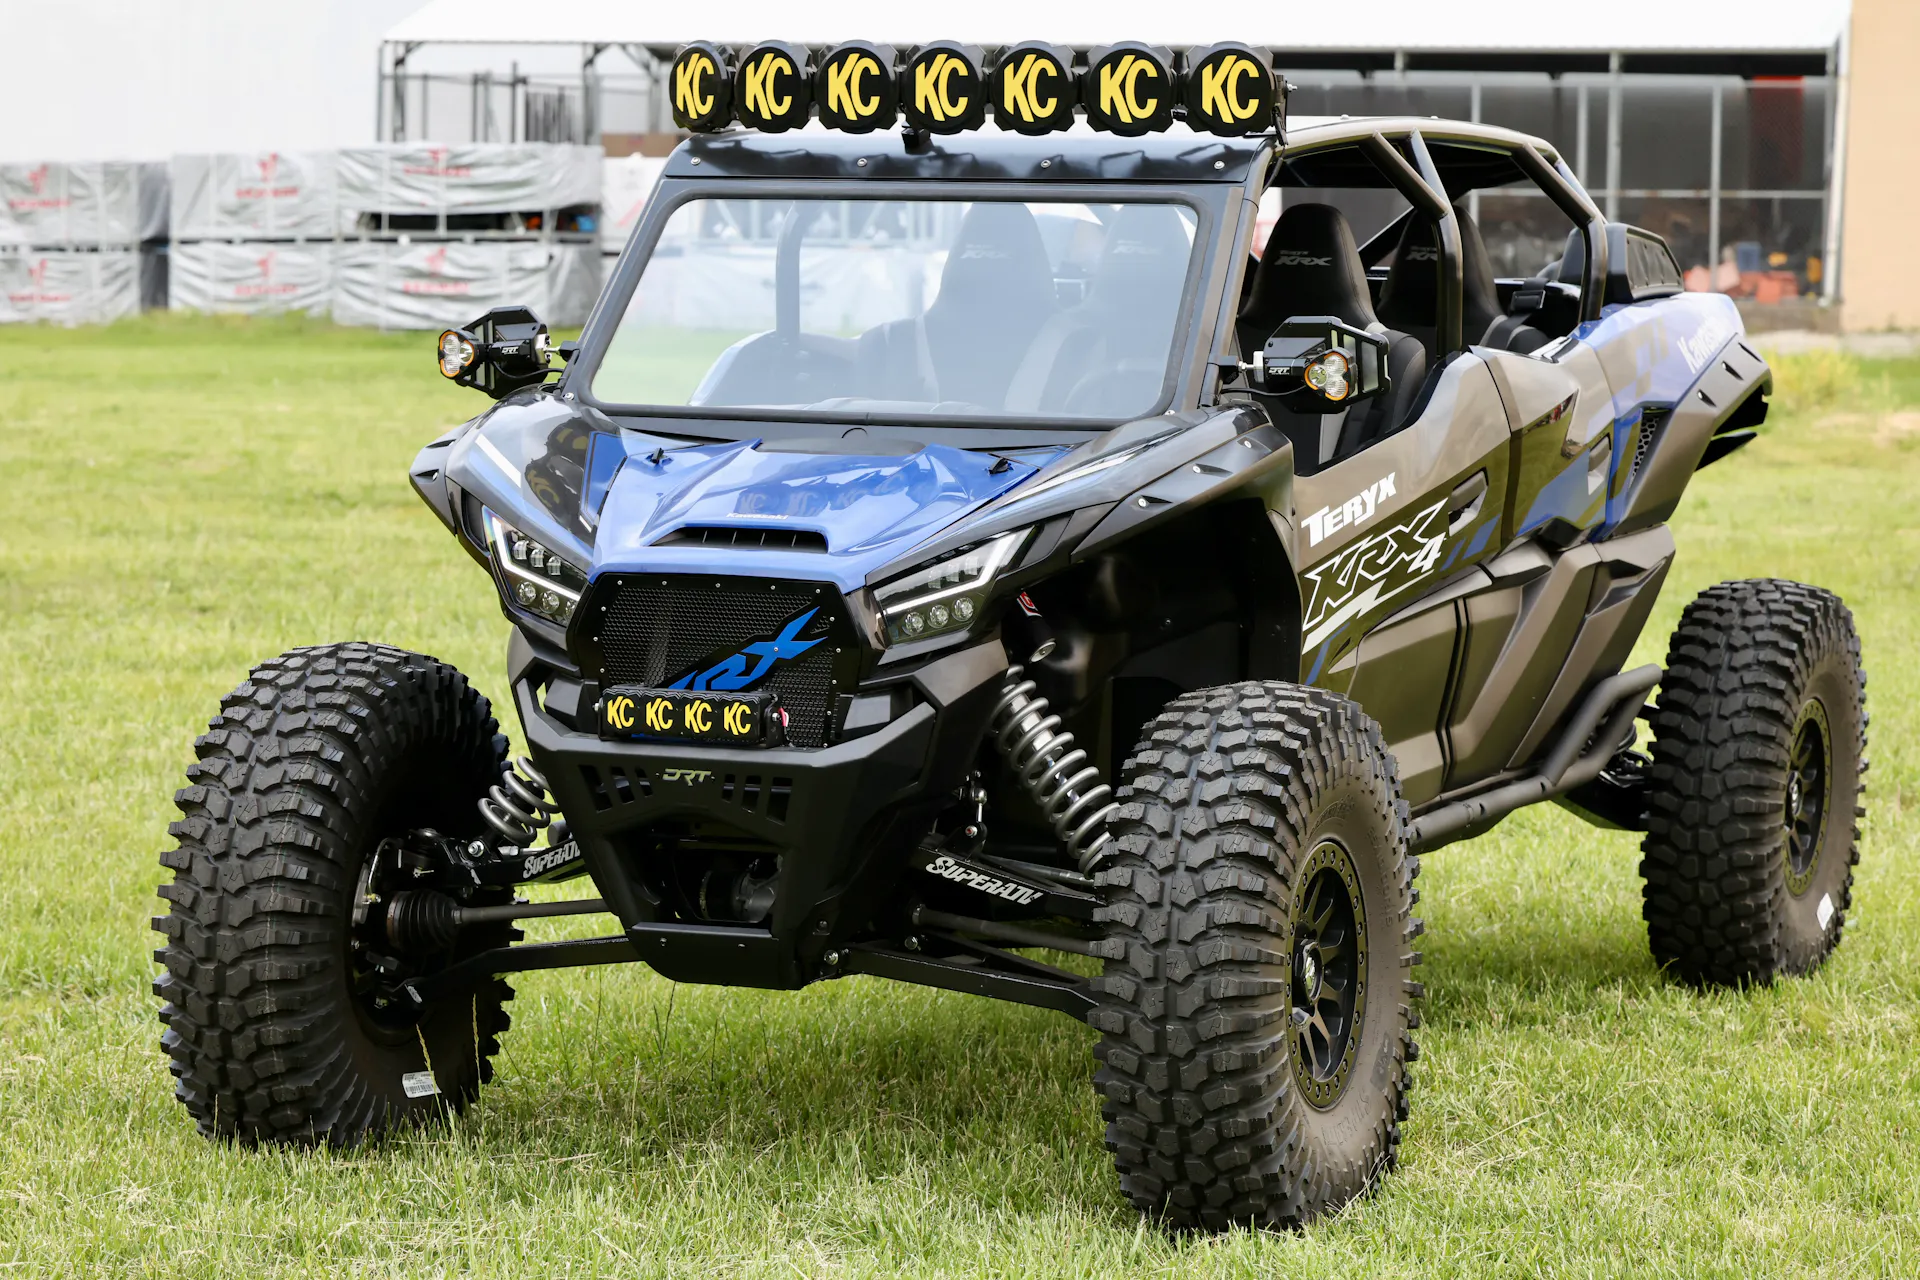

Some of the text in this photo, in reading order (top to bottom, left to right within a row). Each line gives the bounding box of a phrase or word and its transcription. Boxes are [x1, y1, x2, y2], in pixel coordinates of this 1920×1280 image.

[676, 53, 715, 120] KC
[745, 53, 793, 120] KC
[828, 53, 880, 121] KC
[915, 53, 968, 122] KC
[1003, 54, 1058, 122] KC
[1100, 54, 1158, 123] KC
[1202, 55, 1260, 124] KC
[1274, 256, 1333, 266] KRX
[1301, 472, 1397, 547] TERYX
[668, 606, 828, 691] RX
[607, 696, 634, 729] KC
[646, 698, 673, 731] KC
[684, 700, 712, 734] KC
[723, 702, 751, 736] KC
[662, 768, 712, 787] DRT
[925, 856, 1044, 905] SUPERATV
